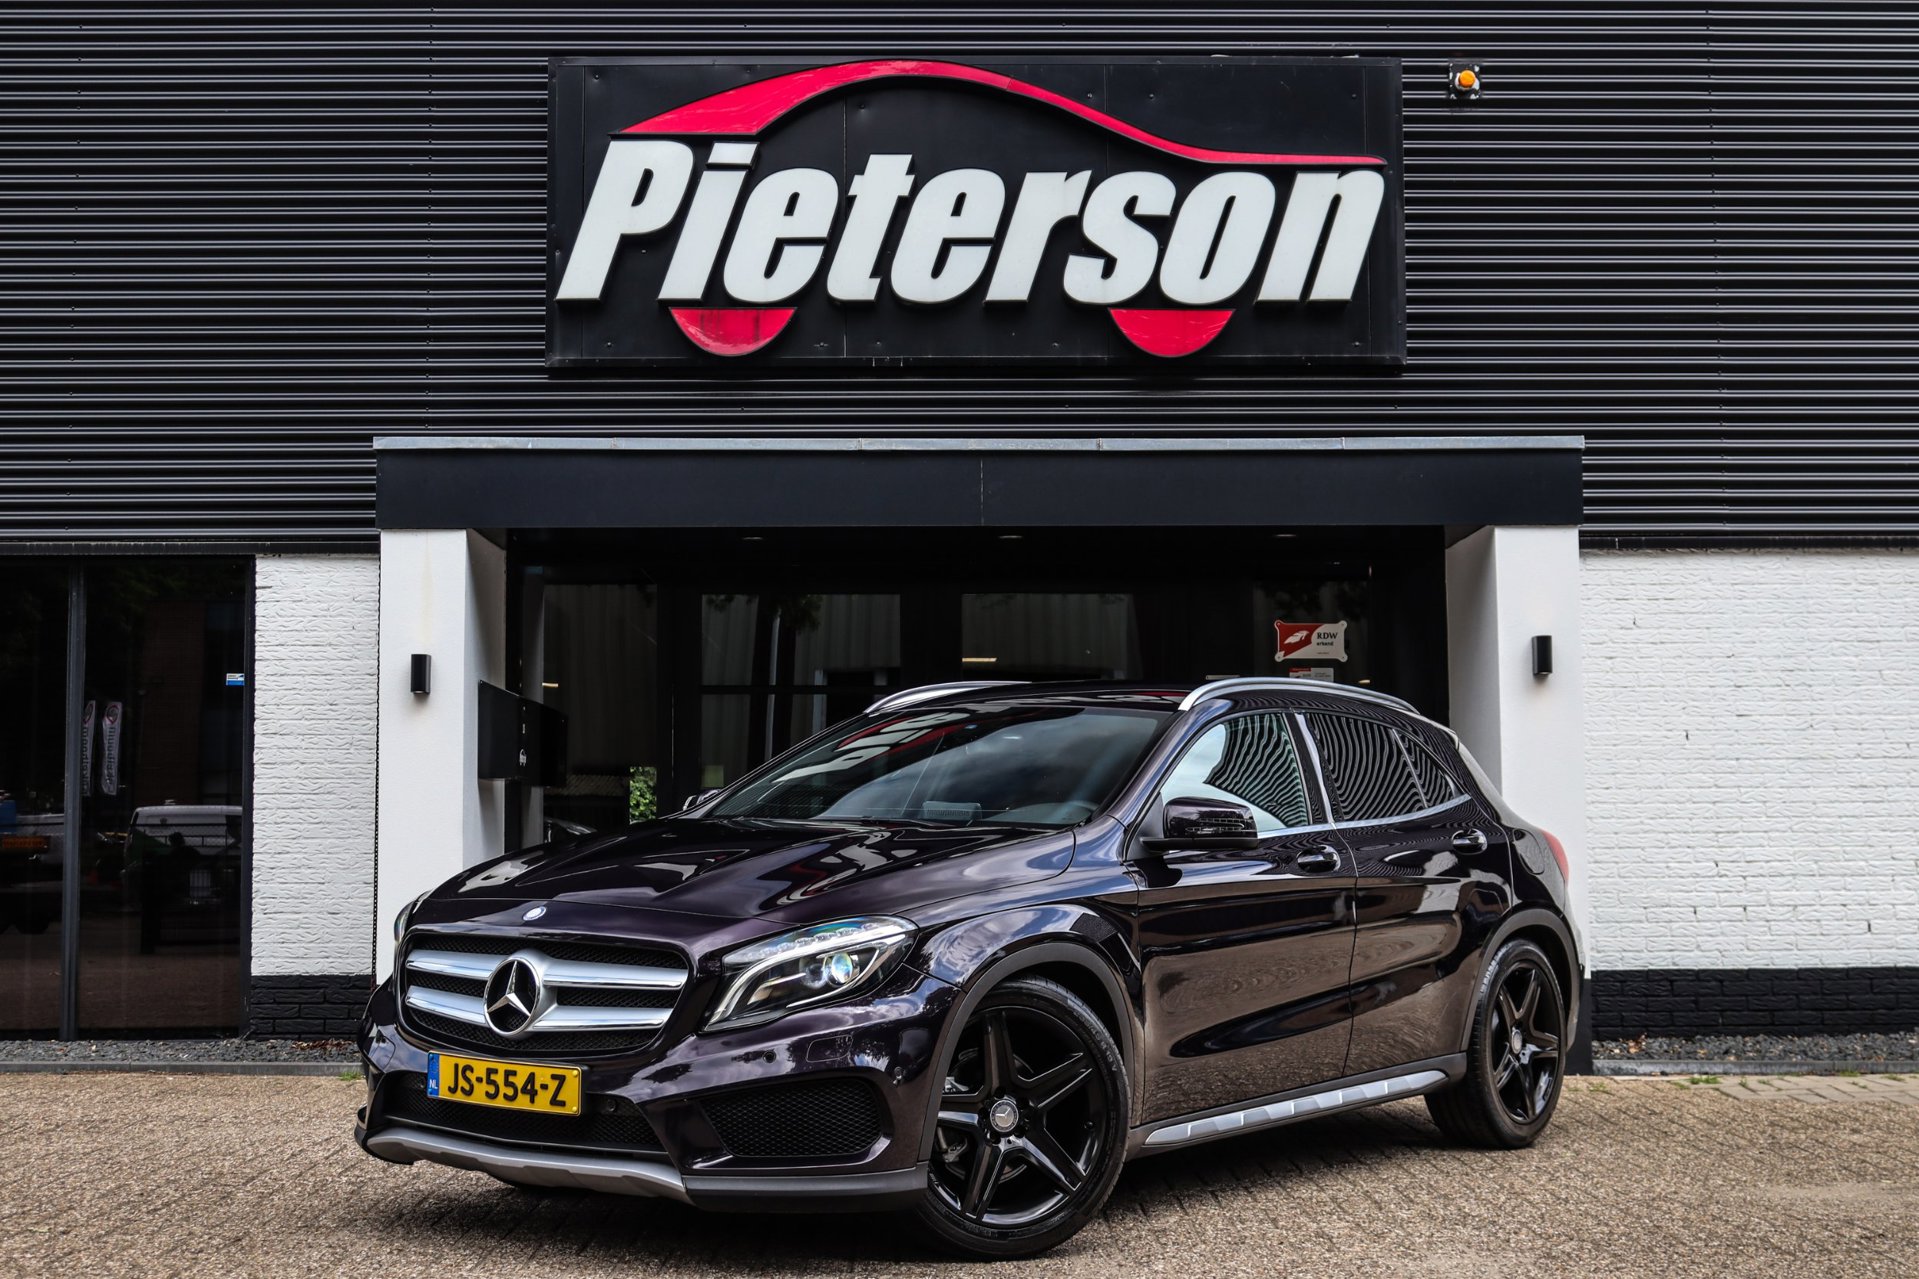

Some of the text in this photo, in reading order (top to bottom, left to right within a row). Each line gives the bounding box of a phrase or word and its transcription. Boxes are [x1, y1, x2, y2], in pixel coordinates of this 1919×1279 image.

[555, 138, 1387, 306] Pieterson
[429, 1079, 438, 1090] NL
[447, 1063, 567, 1107] JS-554-Z
